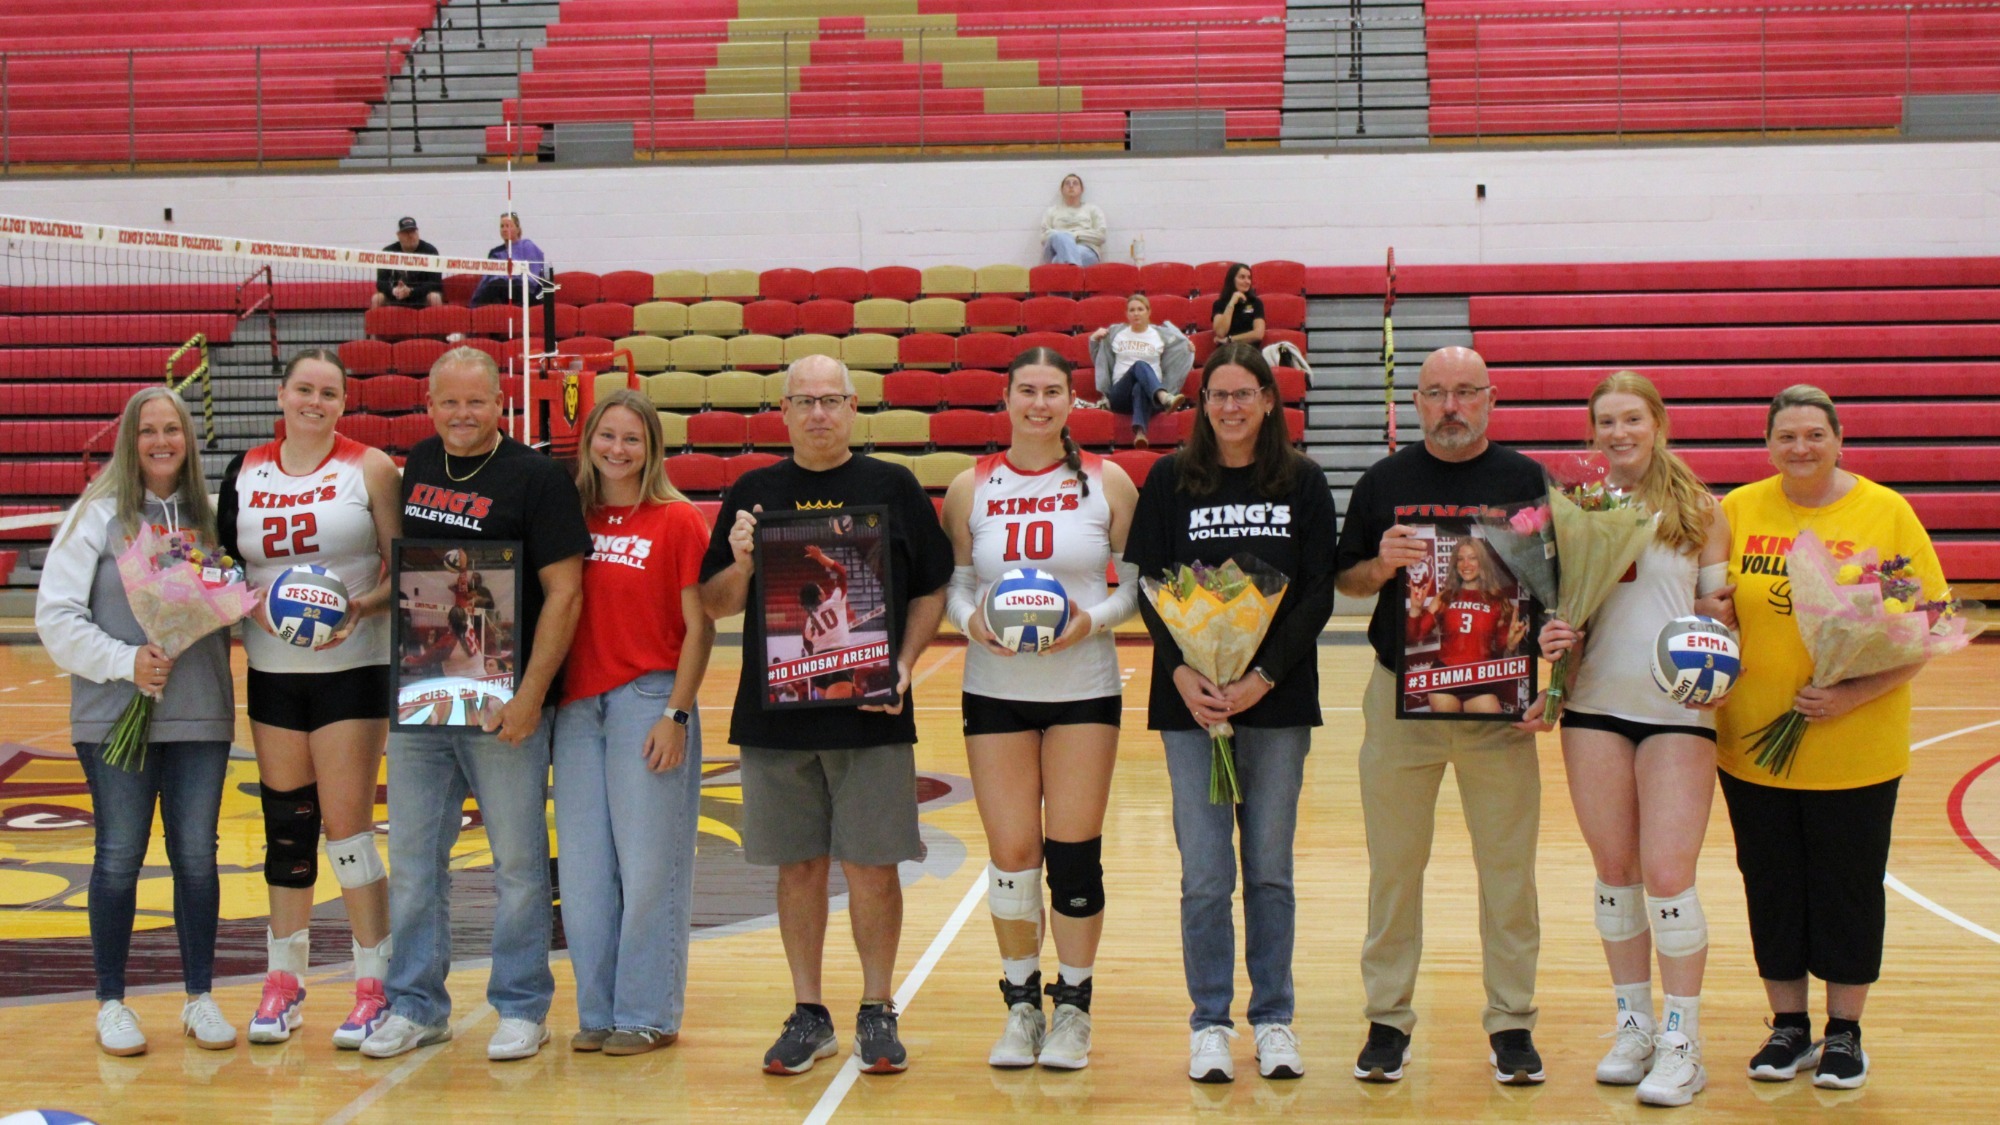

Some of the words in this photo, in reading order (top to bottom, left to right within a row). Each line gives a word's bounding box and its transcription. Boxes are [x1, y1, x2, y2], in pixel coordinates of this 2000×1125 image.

[118, 230, 143, 245] KING'S
[145, 231, 178, 247] COLLEGE
[249, 485, 337, 508] KING'S
[408, 483, 493, 518] KING'S
[987, 493, 1078, 517] KING'S
[404, 504, 482, 532] VOLLEYBALL
[1189, 502, 1291, 530] KING'S
[262, 512, 320, 559] 22
[1003, 520, 1054, 562] 10
[1188, 526, 1291, 541] VOLLEYBALL
[590, 533, 653, 559] NG'S
[1744, 535, 1855, 560] KIN'S
[588, 552, 646, 570] EYBALL
[285, 588, 339, 607] JESSICA
[1006, 595, 1055, 607] LINDSAY
[1449, 601, 1490, 614] KING'S
[303, 607, 321, 619] 22
[811, 608, 838, 637] 10
[1022, 612, 1039, 623] 10
[1459, 613, 1473, 633] 3
[1687, 635, 1728, 652] EMMA
[768, 667, 788, 681] #10
[792, 655, 839, 676] LINDSAY
[843, 643, 889, 665] AREZINA
[1704, 654, 1714, 669] 3
[1408, 674, 1427, 688] #3
[1432, 668, 1473, 686] EMMA
[1478, 660, 1526, 679] BOLICH
[425, 683, 473, 700] JESSICA
